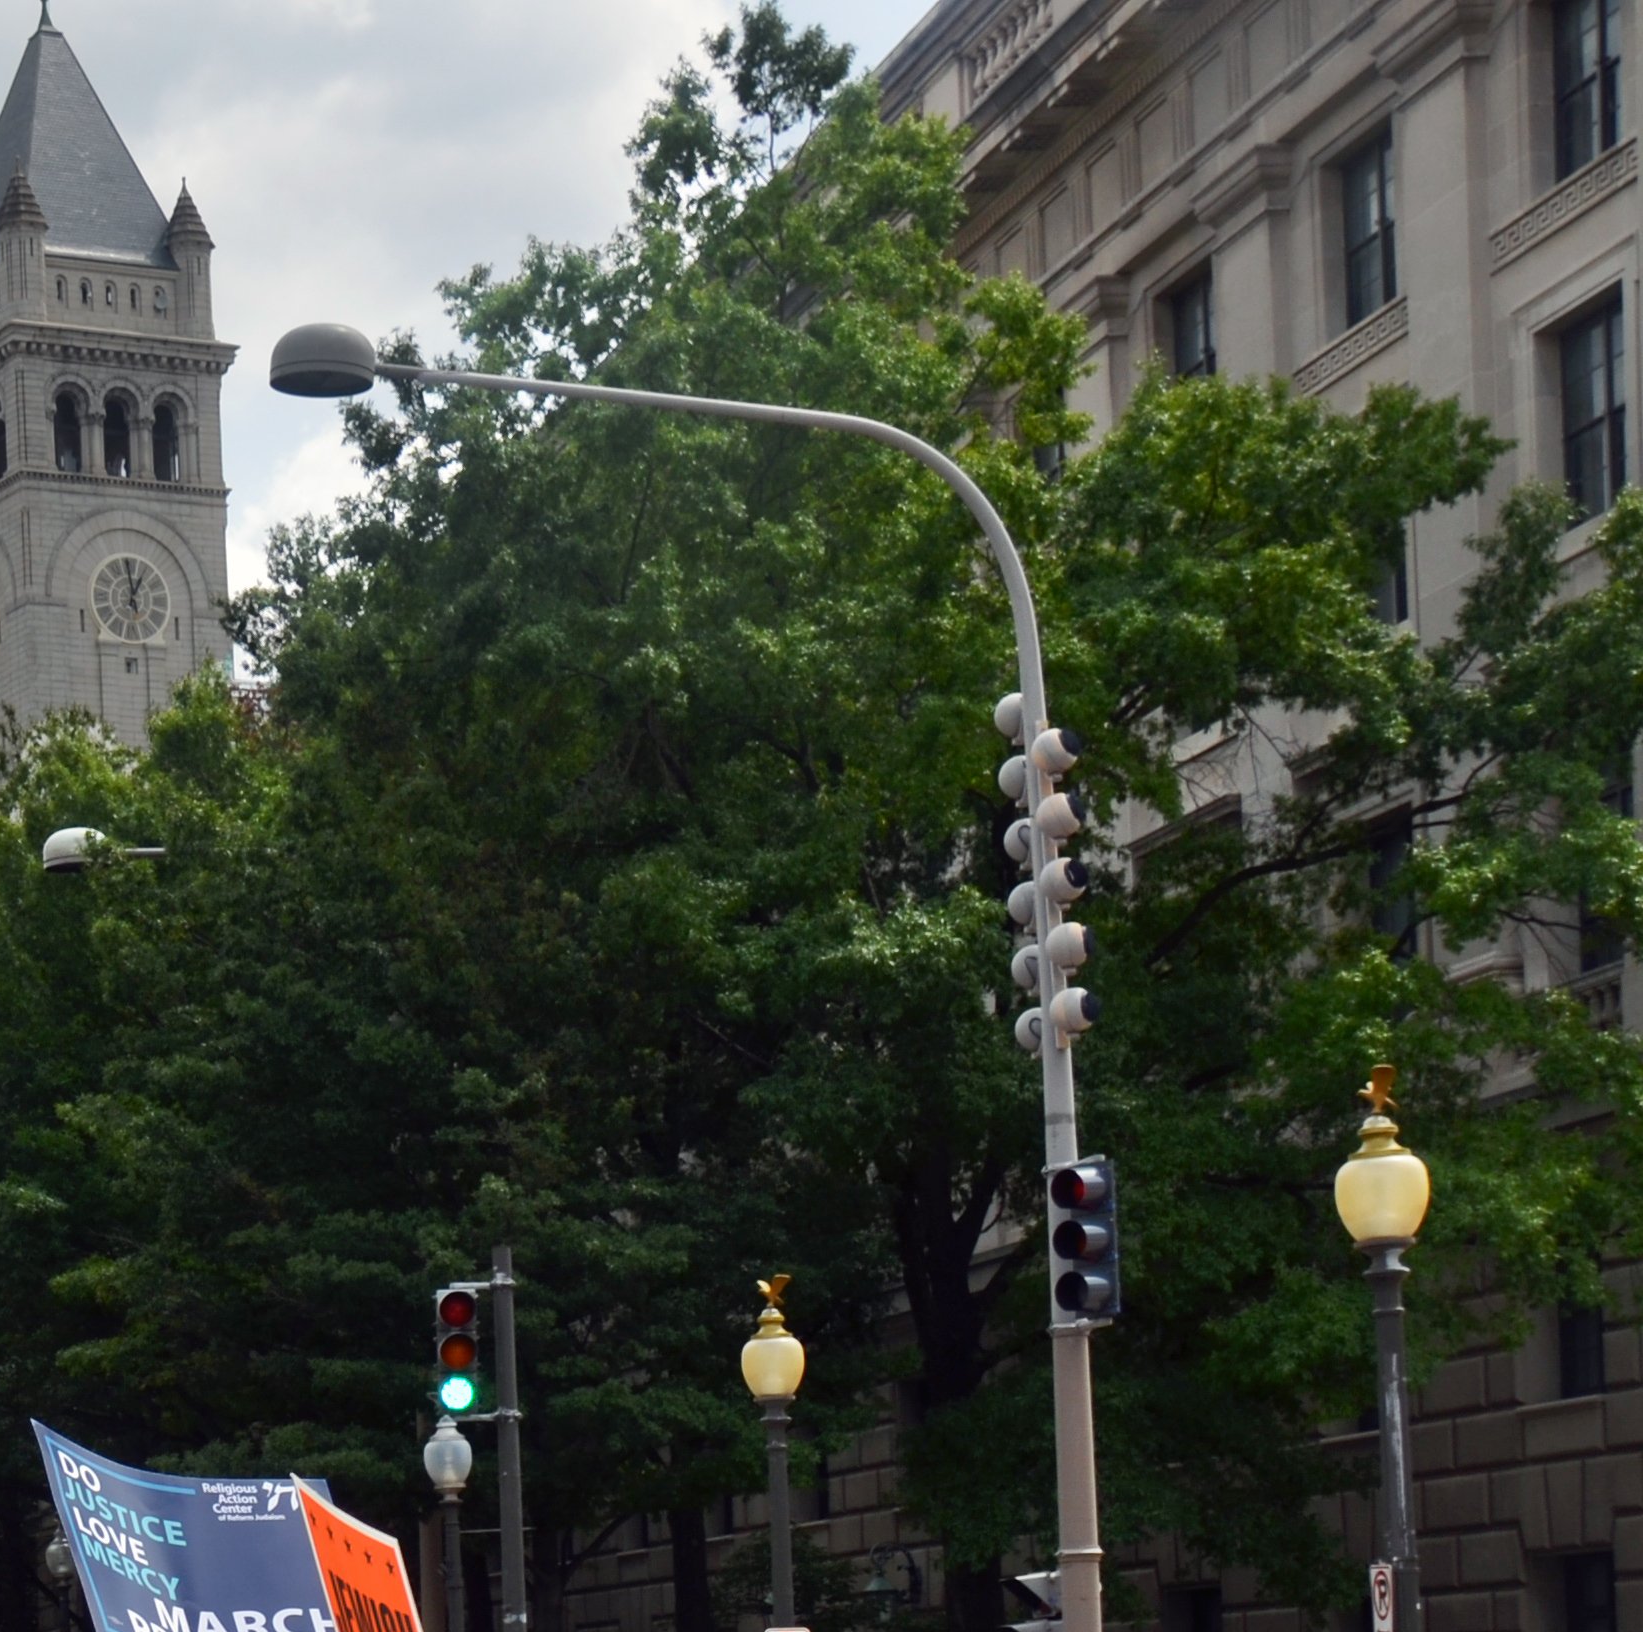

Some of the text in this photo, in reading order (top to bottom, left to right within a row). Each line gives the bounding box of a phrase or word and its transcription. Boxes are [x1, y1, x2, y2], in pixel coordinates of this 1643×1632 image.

[57, 1450, 101, 1493] DO
[201, 1482, 258, 1495] Religious
[65, 1476, 187, 1547] JUSTICE
[212, 1503, 253, 1514] Center
[218, 1494, 258, 1504] Action
[73, 1506, 149, 1566] LOVE
[81, 1533, 179, 1601] MERCY
